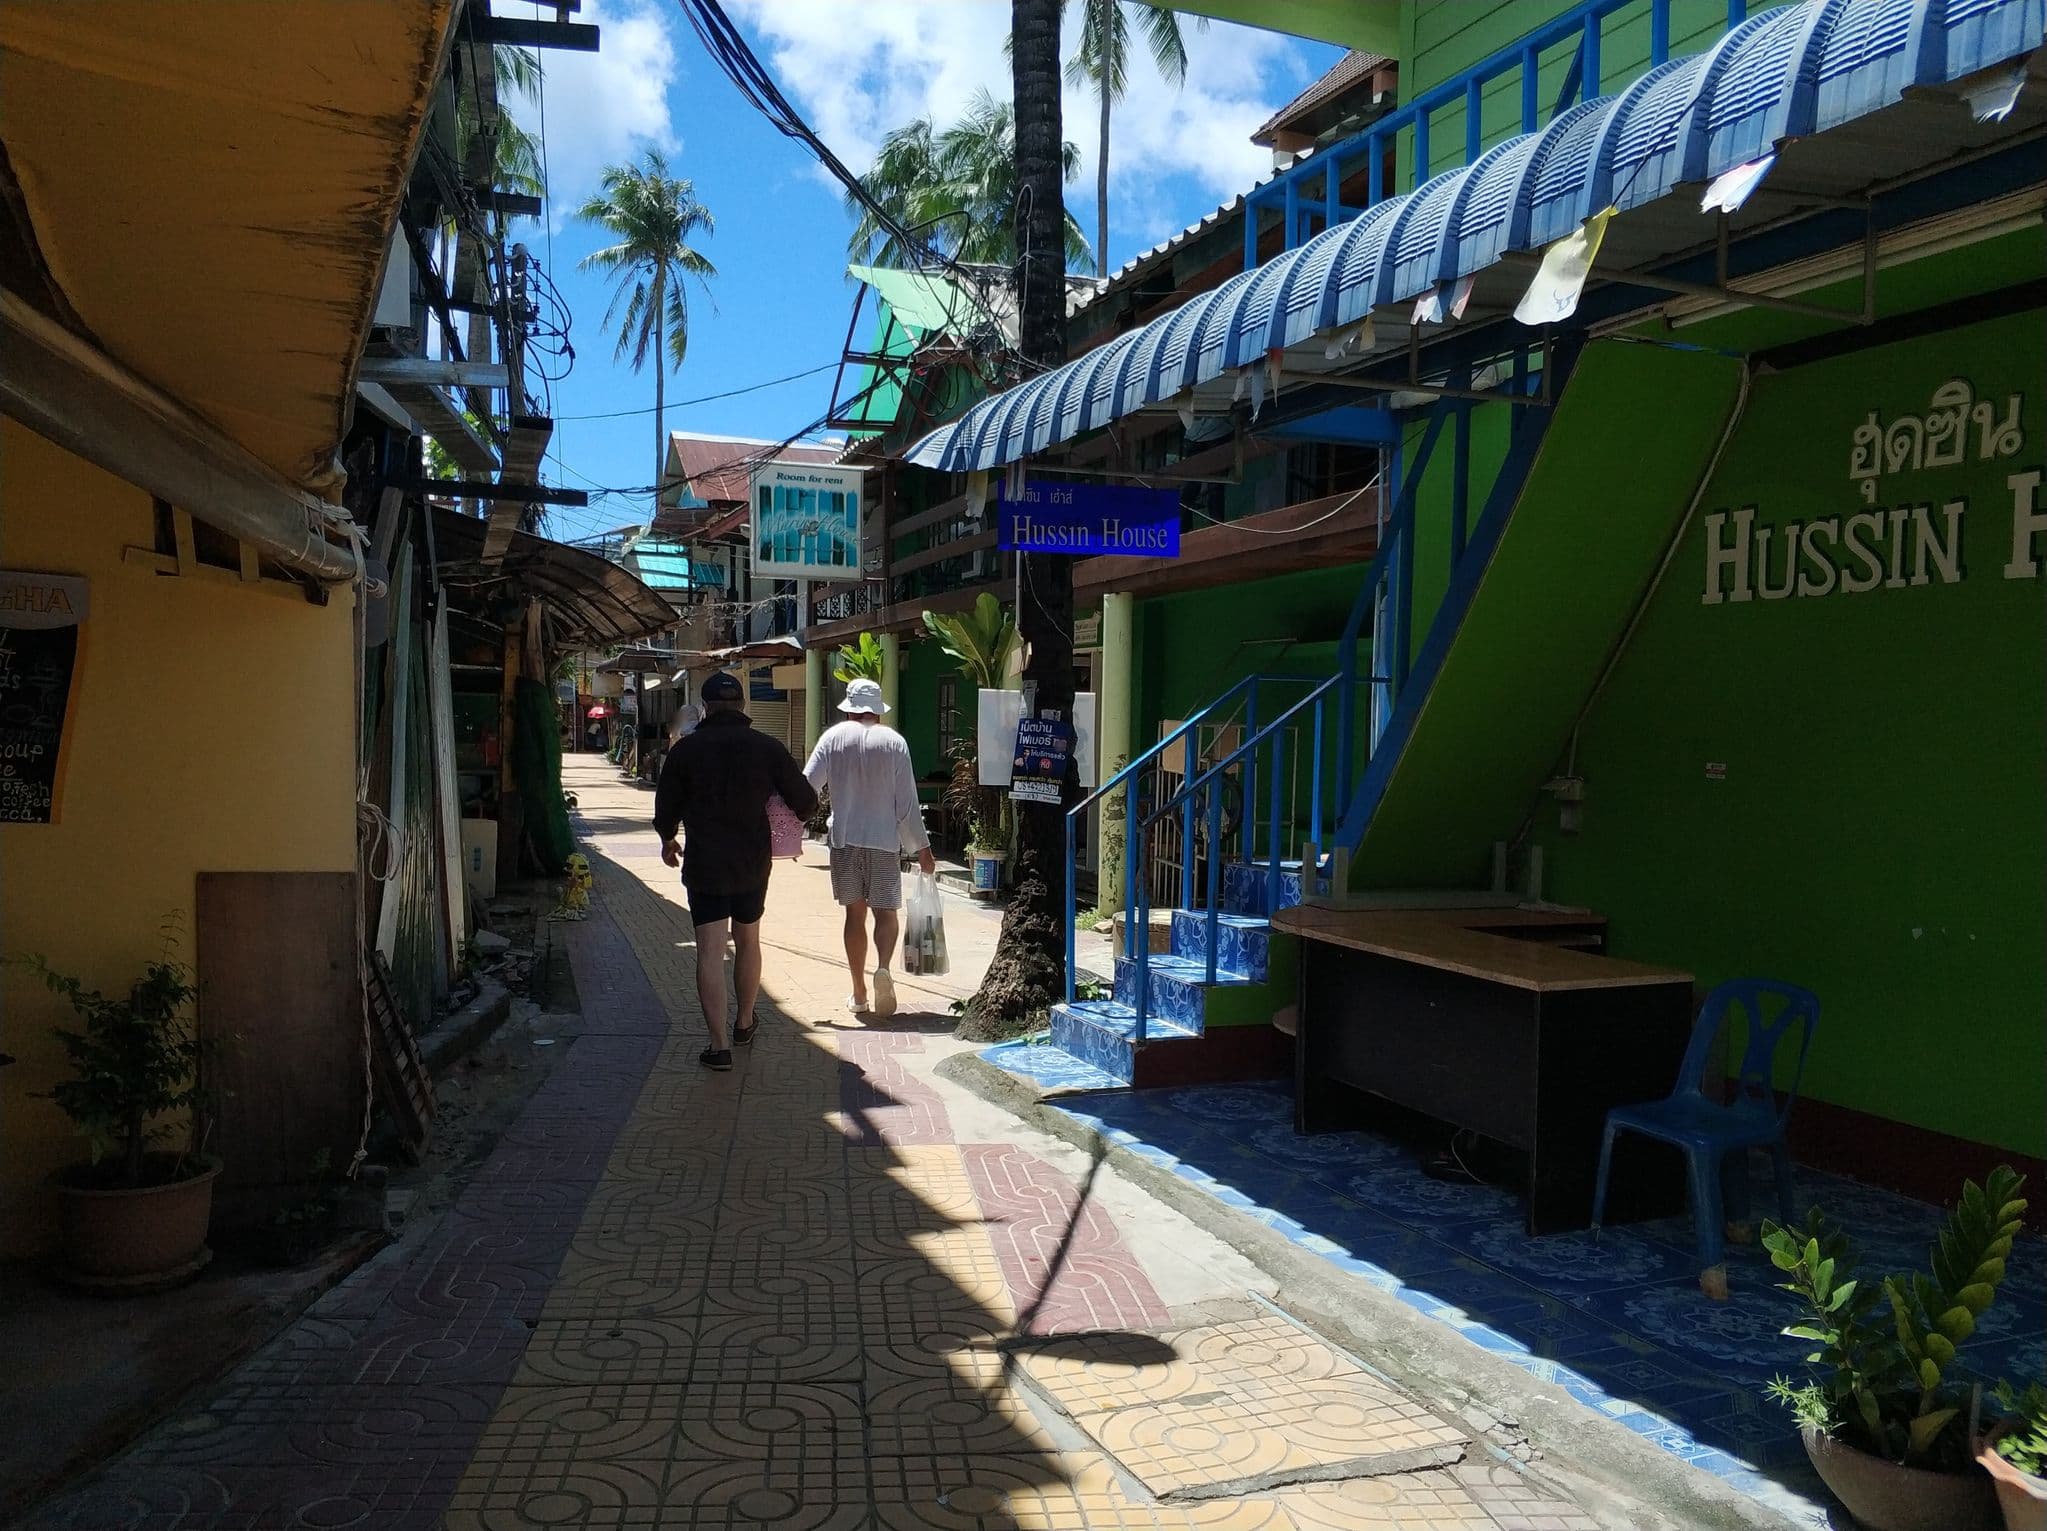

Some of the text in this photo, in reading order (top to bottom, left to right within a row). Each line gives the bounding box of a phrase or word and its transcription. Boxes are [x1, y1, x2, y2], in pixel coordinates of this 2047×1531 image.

[1849, 378, 2025, 504] ฮุดซิน
[776, 472, 844, 485] Room for rent
[1012, 515, 1168, 549] Hussin House
[1702, 501, 1966, 605] HUSSIN
